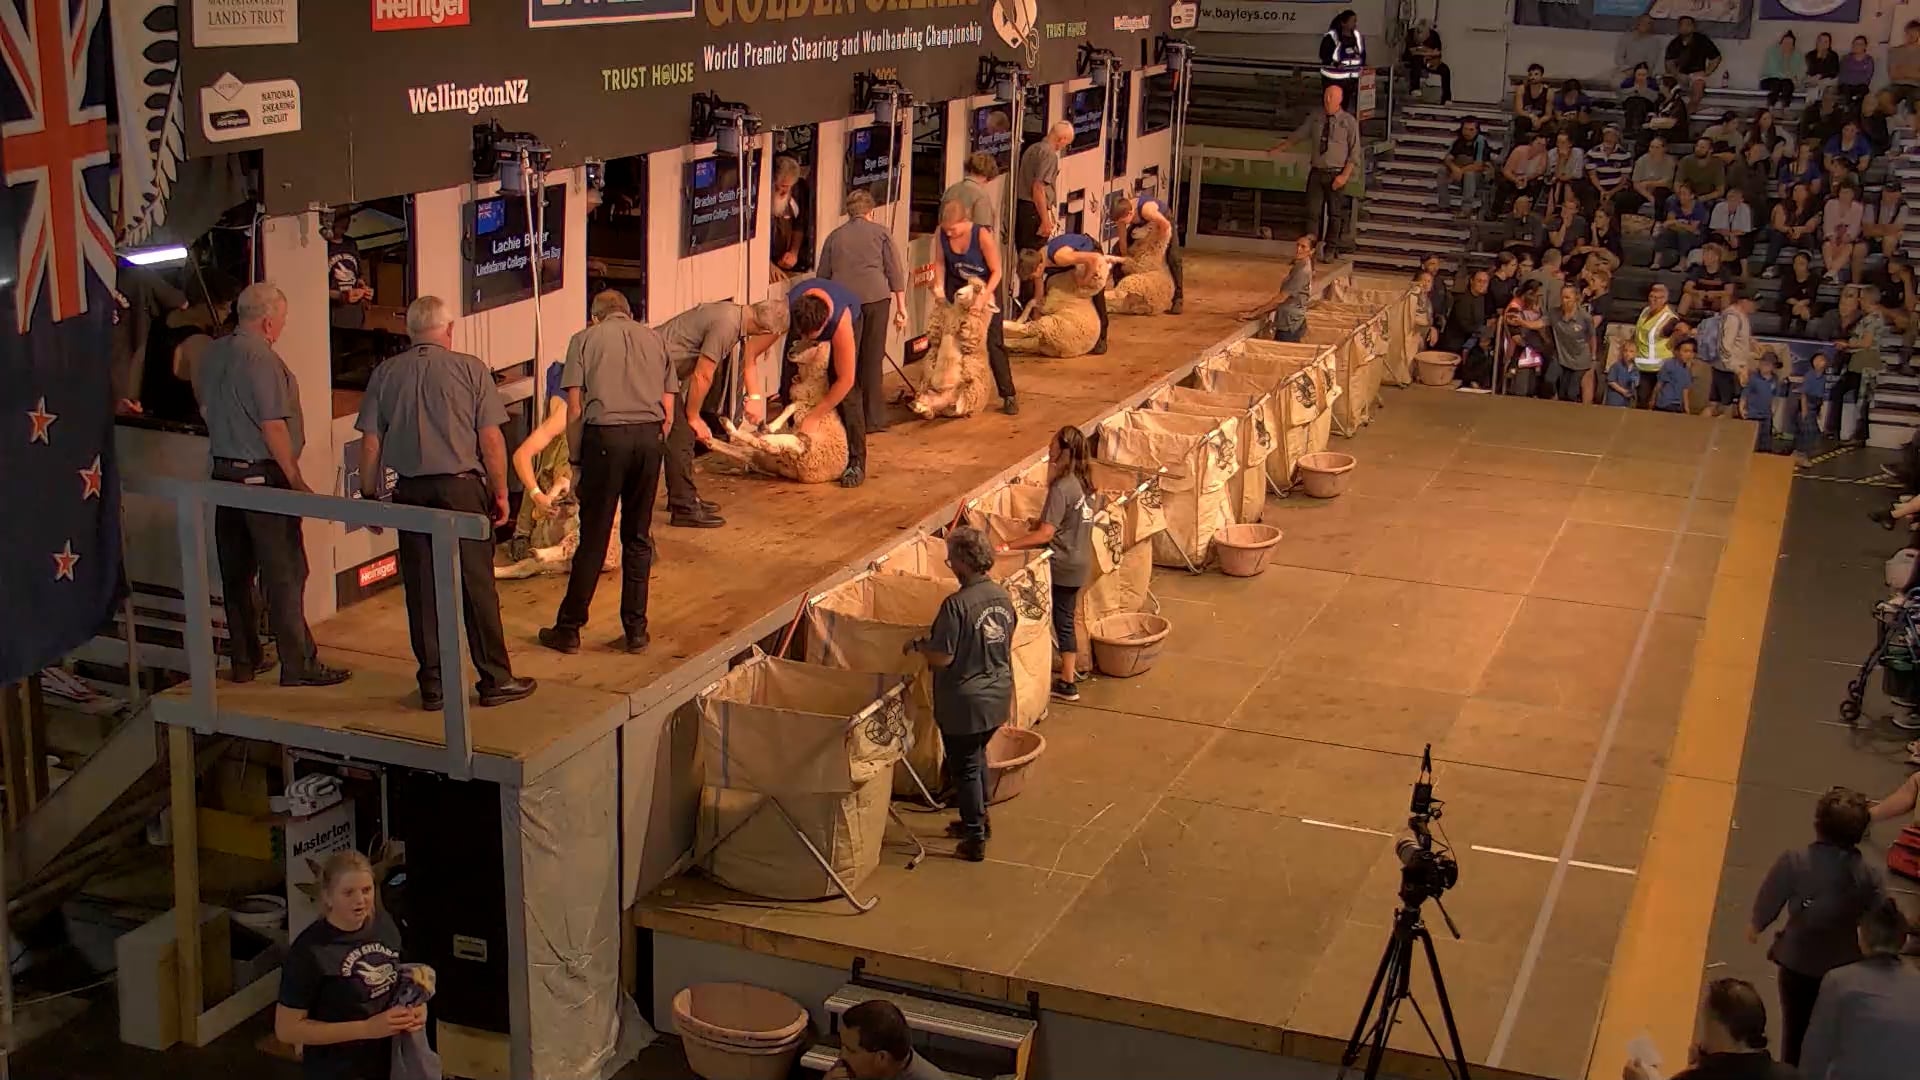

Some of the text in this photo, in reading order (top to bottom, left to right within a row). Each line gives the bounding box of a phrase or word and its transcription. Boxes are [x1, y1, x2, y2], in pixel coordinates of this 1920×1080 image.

[208, 10, 285, 25] LANDS TRUST
[703, 20, 982, 72] World Premier Shearing and Woolhandling Championship
[602, 62, 695, 91] TRUST HOUSE
[262, 89, 295, 101] NATIONAL
[408, 79, 529, 115] WellingtonNZ
[262, 113, 288, 125] CIRCUIT
[493, 236, 521, 254] Lachie
[691, 235, 697, 247] 2
[476, 289, 481, 303] 1
[293, 821, 350, 857] Masterton
